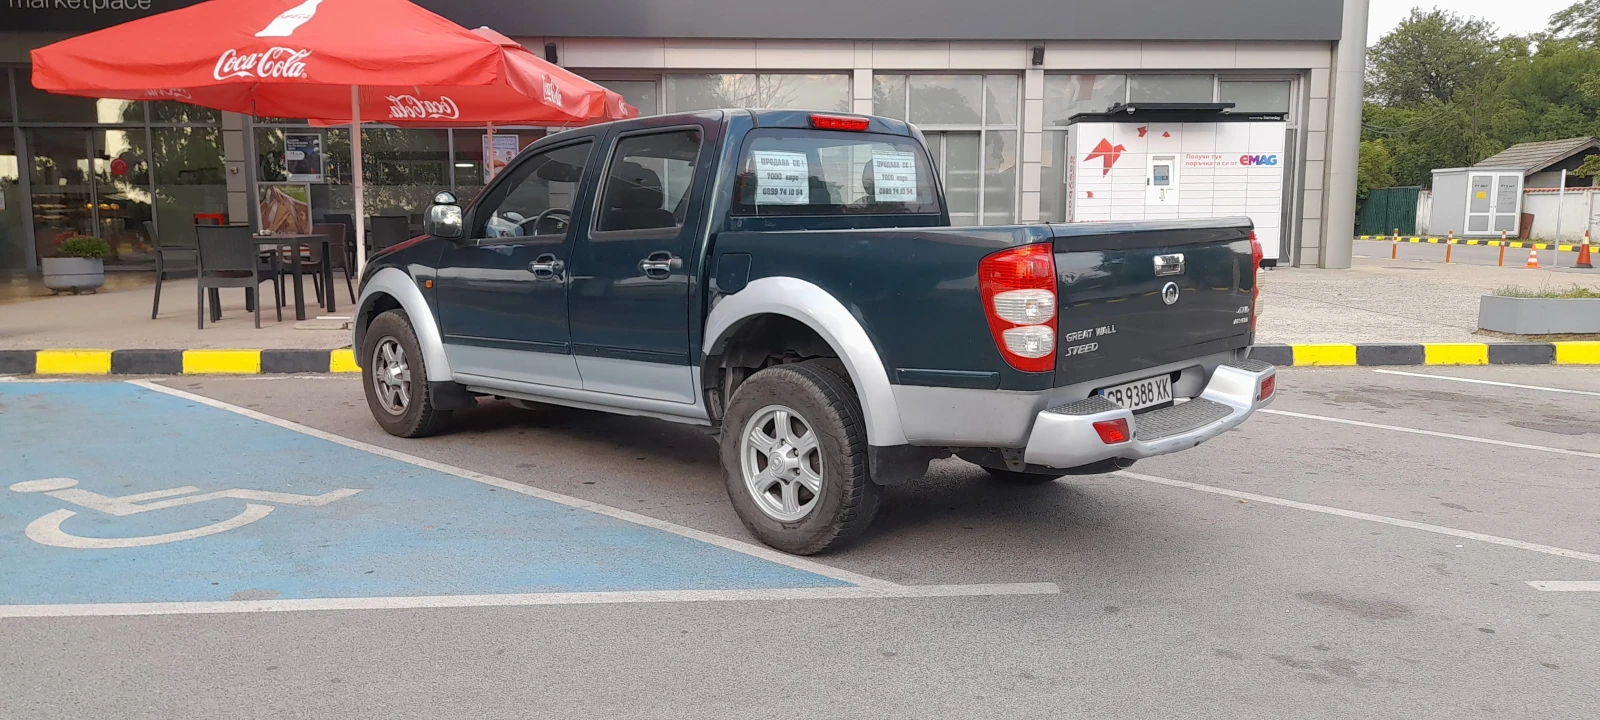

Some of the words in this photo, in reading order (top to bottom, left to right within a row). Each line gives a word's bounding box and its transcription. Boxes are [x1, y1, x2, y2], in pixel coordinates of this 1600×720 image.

[9, 0, 151, 14] marketplace
[213, 46, 312, 80] Coca-Cola
[761, 158, 790, 167] ПРОДАВА
[1240, 155, 1277, 166] eMAG
[1065, 329, 1094, 342] GREAT
[1095, 324, 1117, 337] WALL
[1065, 342, 1099, 357] STEED
[1125, 381, 1155, 408] 9388
[1155, 377, 1170, 402] XK
